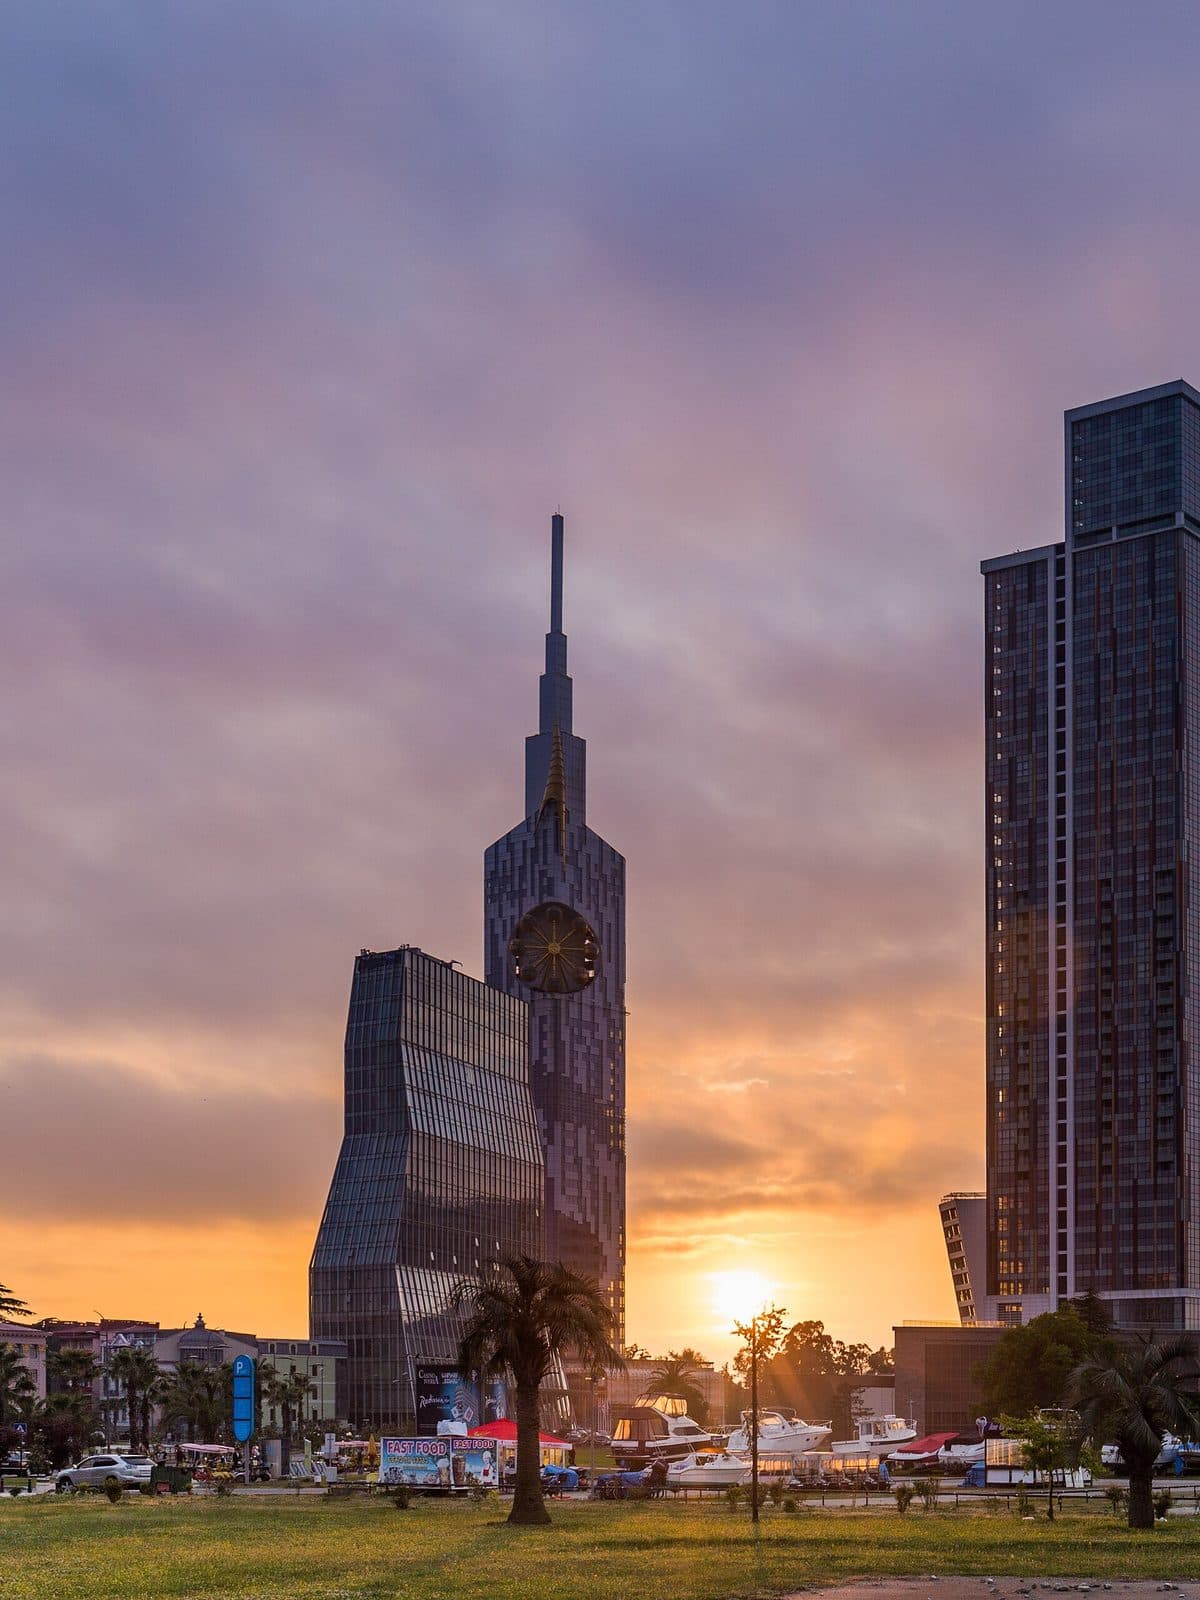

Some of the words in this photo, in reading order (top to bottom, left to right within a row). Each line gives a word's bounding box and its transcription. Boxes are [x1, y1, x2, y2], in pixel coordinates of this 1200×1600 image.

[236, 1361, 244, 1375] P
[387, 1440, 414, 1454] FAST
[416, 1441, 447, 1455] FOOD
[453, 1440, 472, 1448] FAST
[473, 1440, 495, 1448] FOOD
